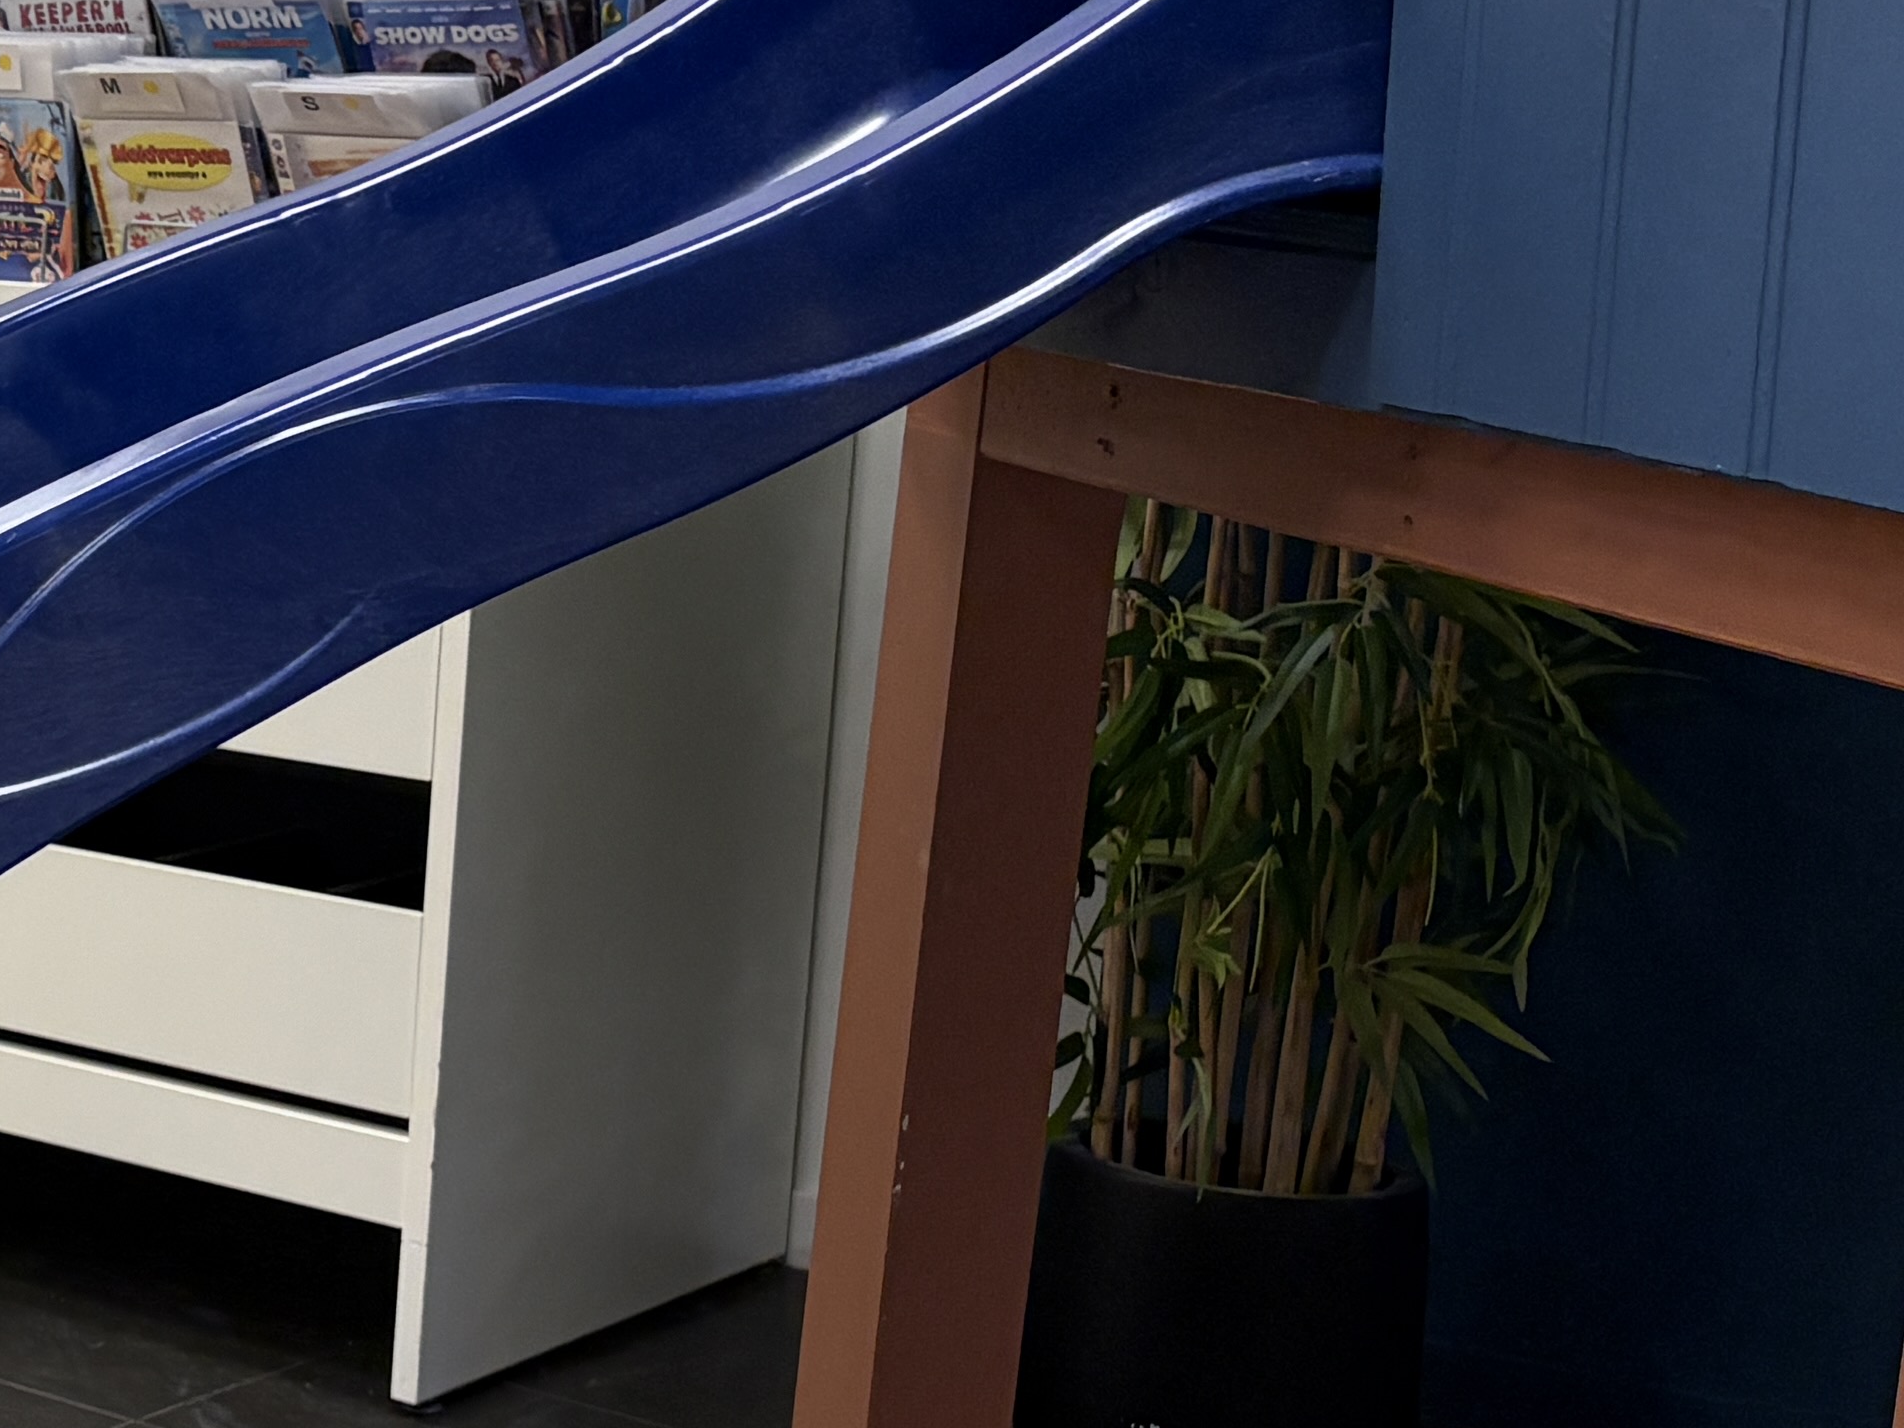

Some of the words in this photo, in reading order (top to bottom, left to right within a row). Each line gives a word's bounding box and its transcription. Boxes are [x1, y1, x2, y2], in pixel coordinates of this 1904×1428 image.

[18, 0, 126, 29] KEEPER'N
[202, 6, 303, 30] NORM
[374, 26, 446, 45] SHOW
[452, 23, 520, 44] DOGS
[99, 78, 121, 95] M
[303, 95, 320, 111] S
